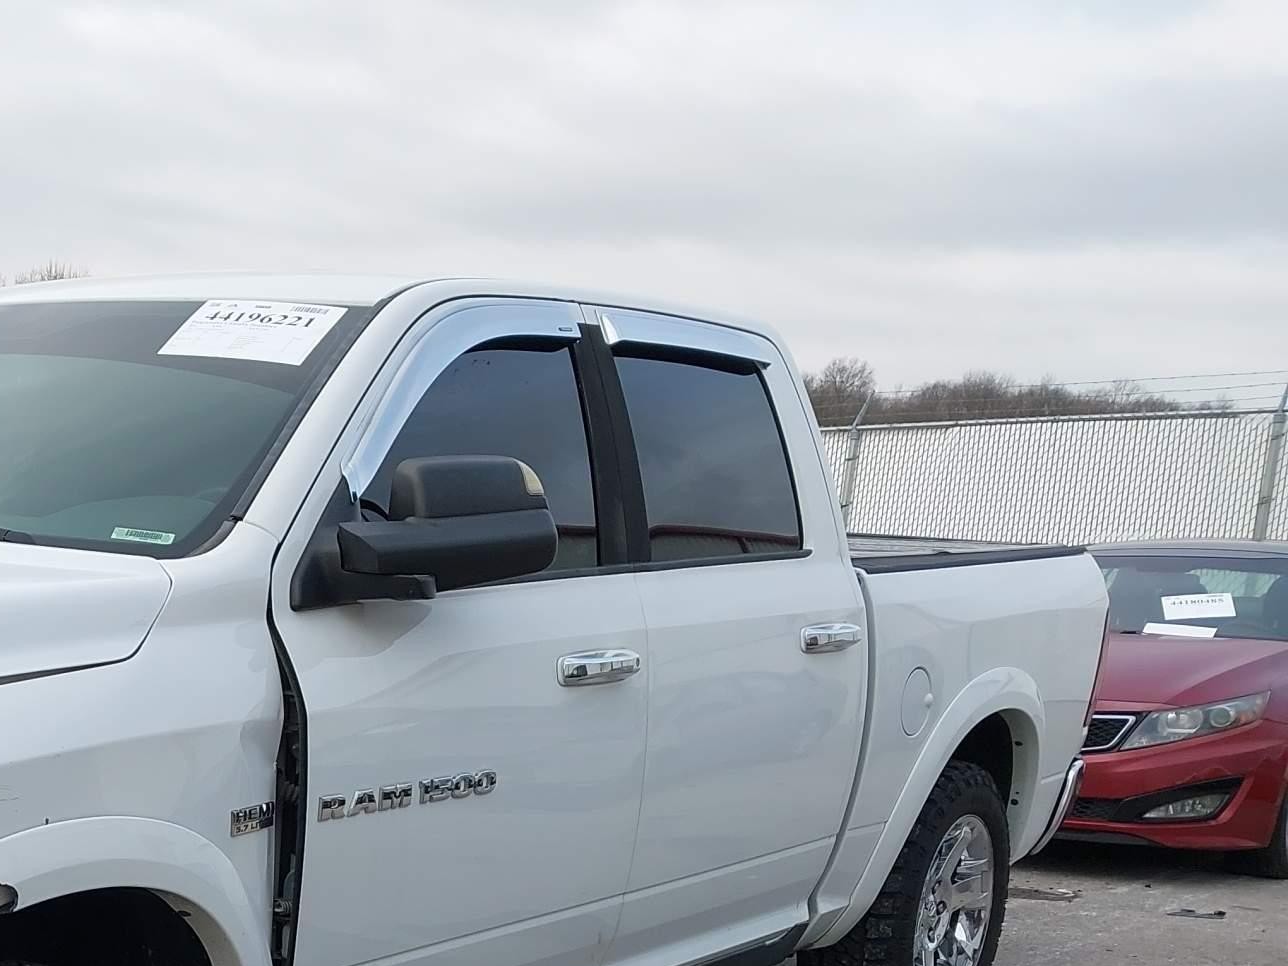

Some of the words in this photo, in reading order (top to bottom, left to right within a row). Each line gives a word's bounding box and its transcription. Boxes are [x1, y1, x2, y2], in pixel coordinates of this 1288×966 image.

[205, 309, 316, 328] 44196221
[317, 782, 413, 822] RAM
[418, 768, 497, 805] 1500
[233, 801, 275, 823] HEMI
